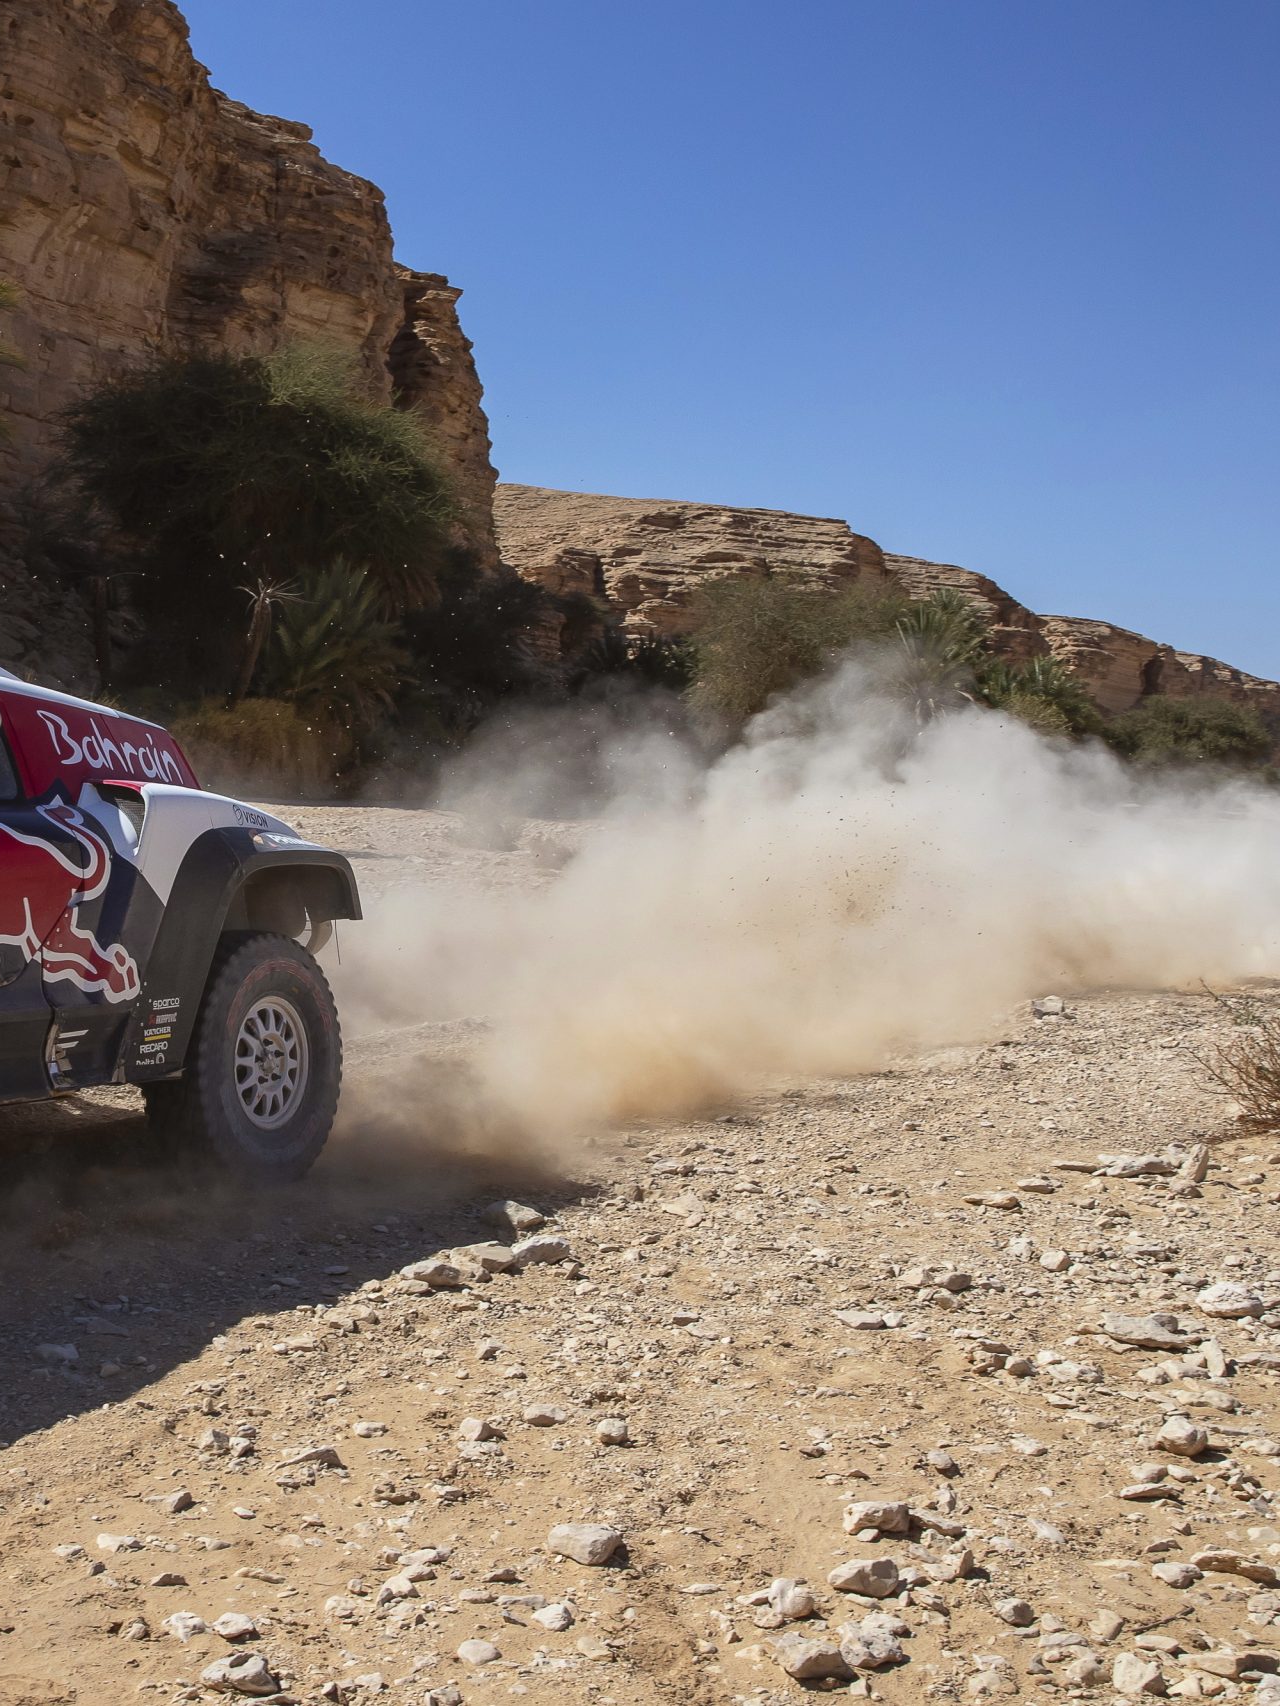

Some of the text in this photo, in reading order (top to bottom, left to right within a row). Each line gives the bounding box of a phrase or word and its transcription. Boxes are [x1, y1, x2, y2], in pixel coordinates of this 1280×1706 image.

[36, 709, 184, 784] Bahrain
[242, 810, 269, 828] VISION
[152, 997, 180, 1010] sparco
[139, 1041, 168, 1054] RECARO
